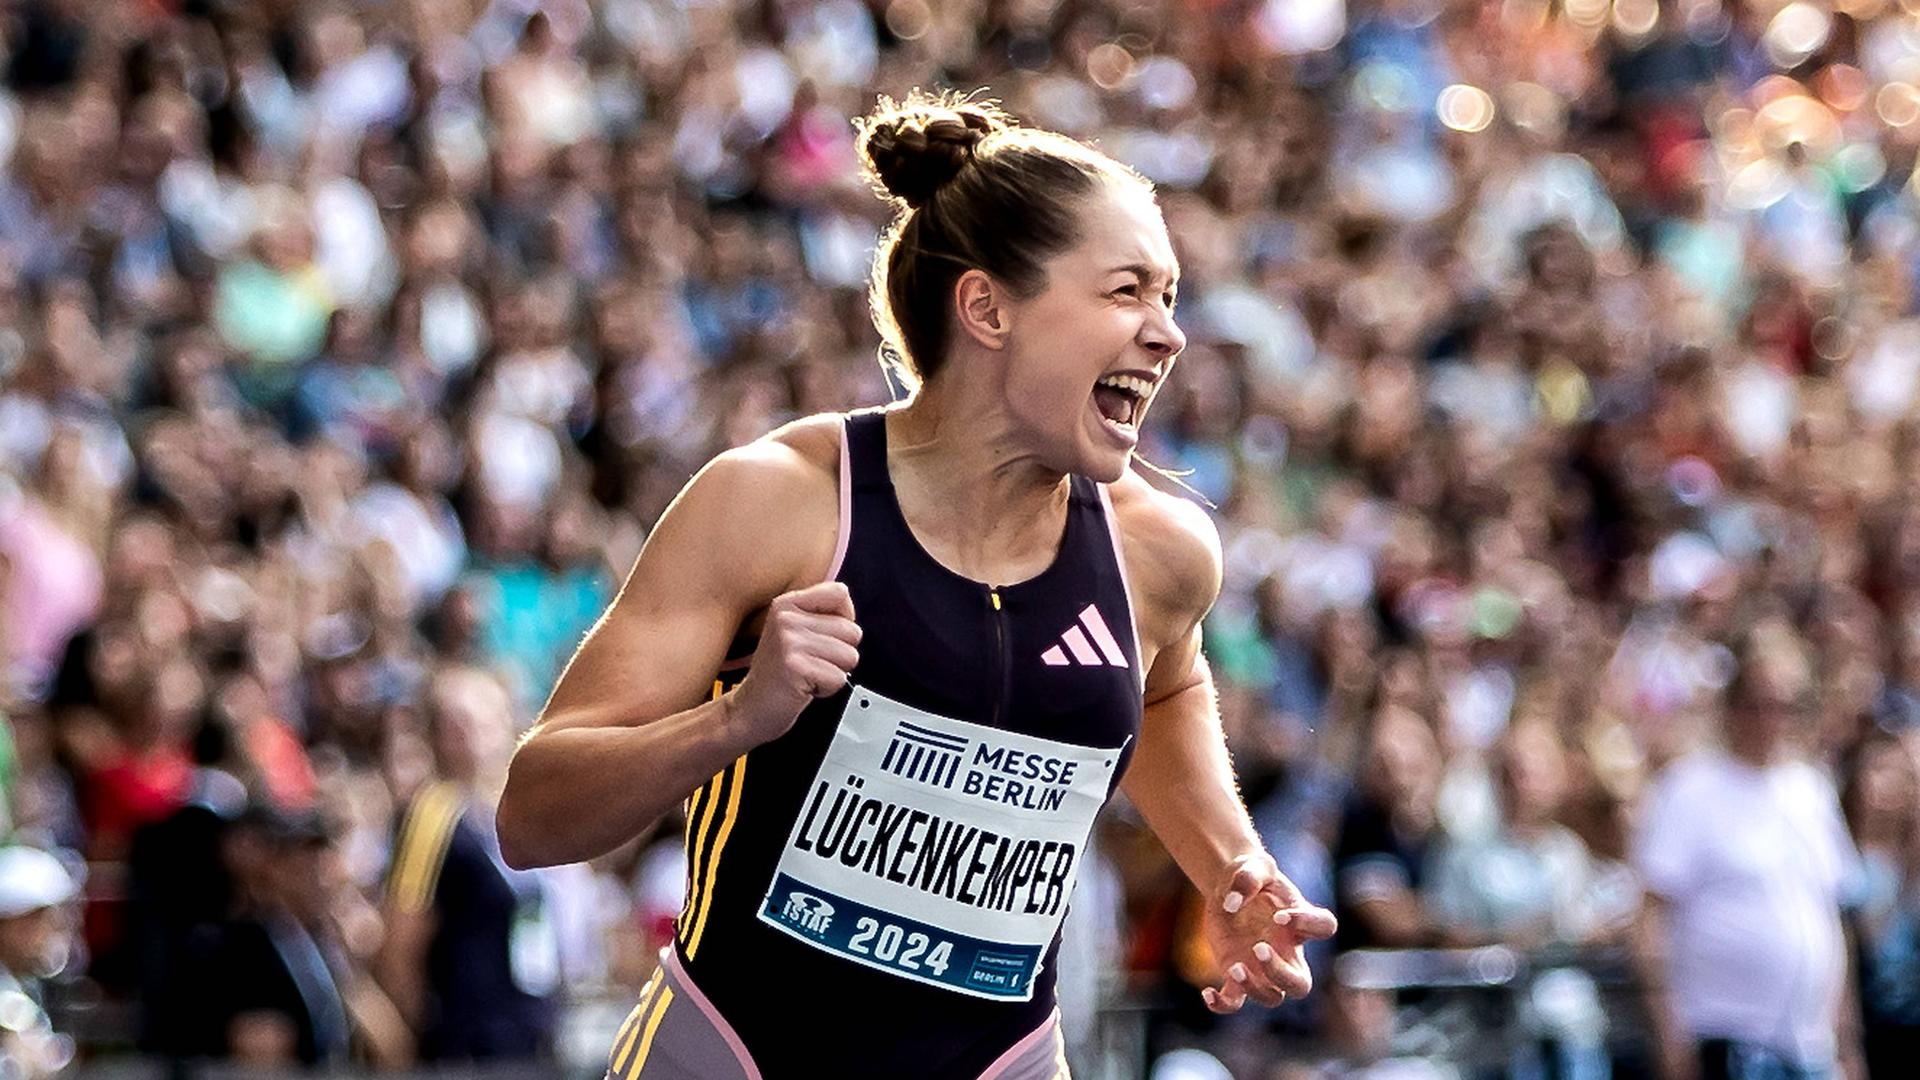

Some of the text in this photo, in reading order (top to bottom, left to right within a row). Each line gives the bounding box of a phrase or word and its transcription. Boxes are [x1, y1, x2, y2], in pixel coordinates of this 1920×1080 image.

[972, 742, 1078, 785] MESSE
[963, 774, 1067, 811] BERLIN
[794, 775, 1075, 916] LÜCKENKEMPER
[782, 900, 833, 934] ISTAF
[848, 916, 954, 976] 2024
